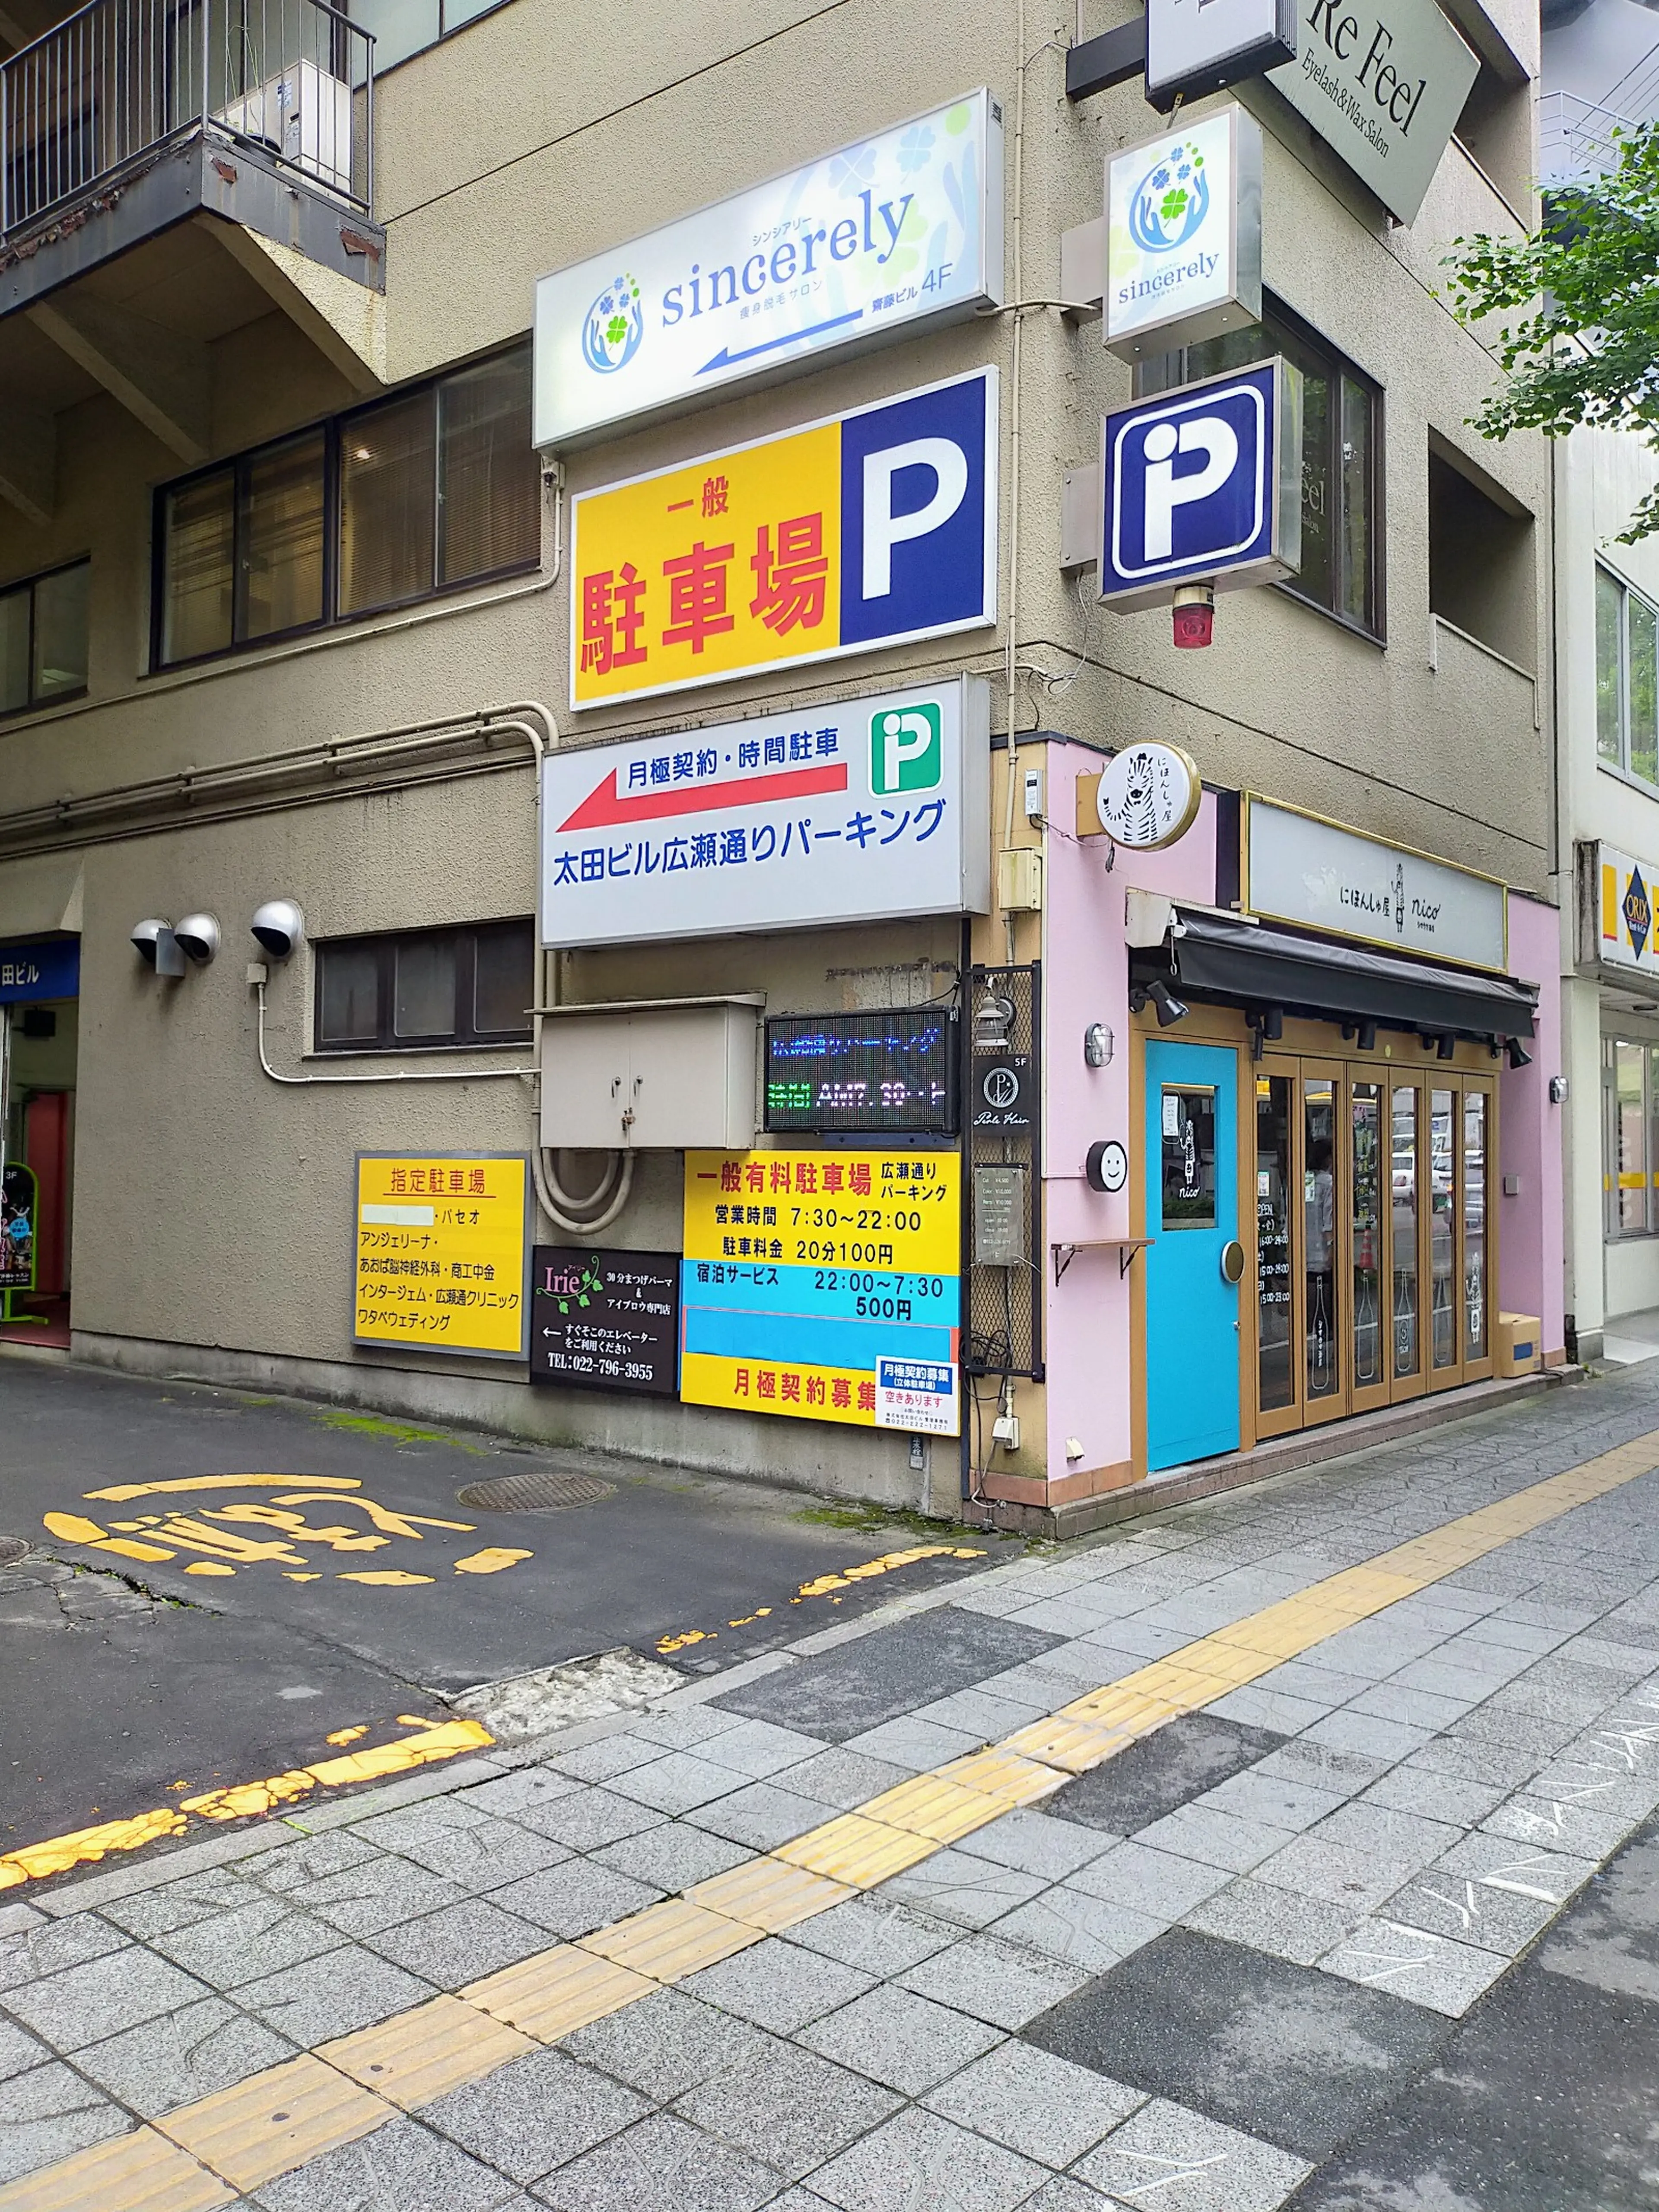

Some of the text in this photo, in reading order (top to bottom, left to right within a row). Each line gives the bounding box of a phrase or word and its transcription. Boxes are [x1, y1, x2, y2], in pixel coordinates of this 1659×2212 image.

[1354, 19, 1427, 137] Feel
[1364, 119, 1390, 159] Salon
[752, 217, 813, 247] シンシアリー
[661, 189, 915, 328] sincerely
[922, 263, 953, 293] 4F
[1119, 252, 1220, 304] sincerely
[667, 475, 730, 519] 一般
[862, 436, 968, 601] P
[580, 512, 829, 676] 駐車場
[628, 727, 839, 789] 月極契約・時間駐車
[553, 798, 947, 887] 太田ビル広瀬通りパーキング
[1411, 898, 1441, 920] nico
[1626, 894, 1649, 924] ORIX
[1, 961, 40, 987] 田ビル
[1015, 1058, 1027, 1067] 5F
[1003, 1111, 1030, 1125] Hair
[6, 1171, 17, 1180] 3F
[391, 1168, 485, 1194] 指定駐車場
[697, 1160, 872, 1197] 一般有料駐車場
[881, 1162, 937, 1181] 広瀬通り
[881, 1184, 948, 1202] パーキング
[1179, 1186, 1201, 1199] nico
[715, 1204, 777, 1226] 営業時間
[723, 1236, 893, 1265] 駐車料金 20分100円
[544, 1267, 580, 1294] Irie
[696, 1264, 779, 1286] 宿泊サービス
[636, 1287, 642, 1298] &
[358, 1309, 451, 1331] ワタベウェディング
[607, 1299, 672, 1316] アイブロウ専門店
[856, 1296, 912, 1321] 500円
[564, 1338, 631, 1355] をご利用ください
[565, 1324, 658, 1344] すぐそこのエレベーター
[734, 1368, 876, 1411] 月極契約募集
[885, 1391, 943, 1408] 空きあります
